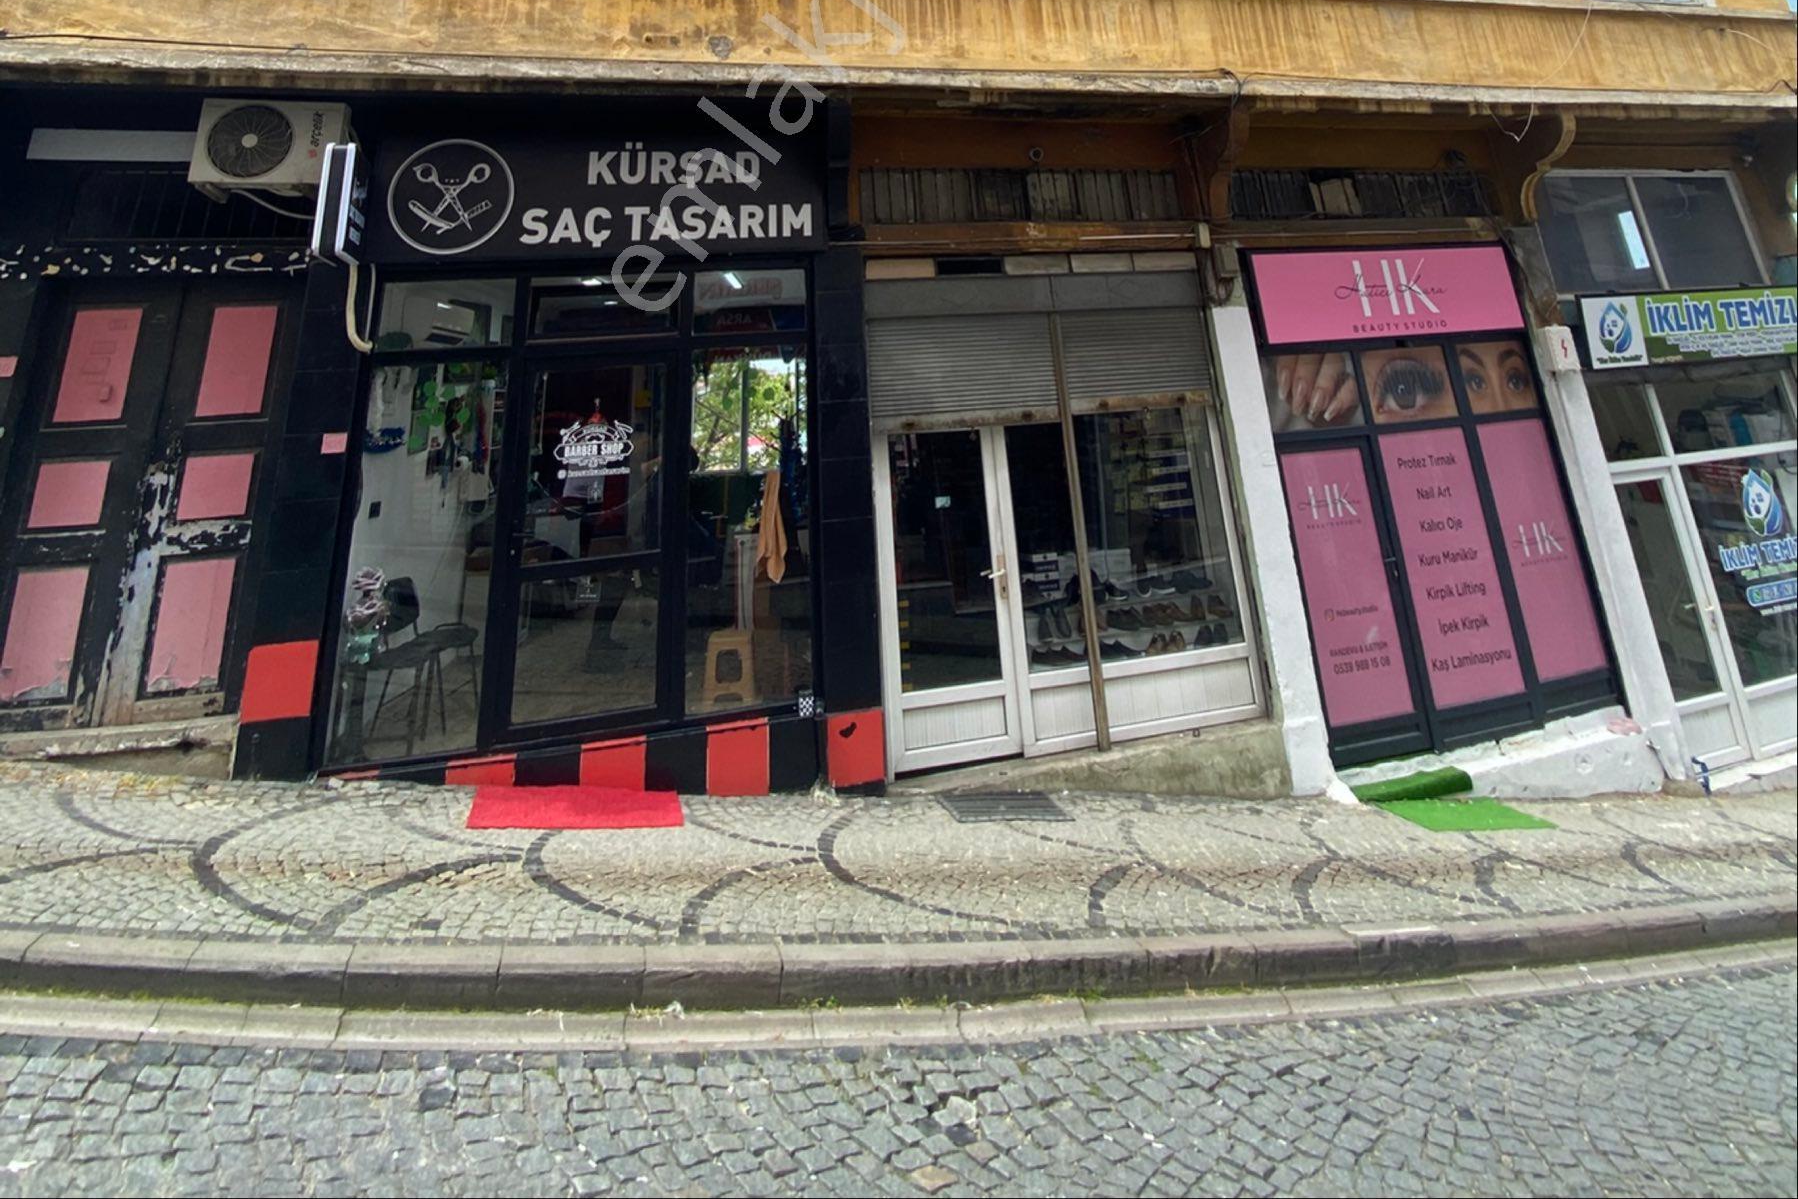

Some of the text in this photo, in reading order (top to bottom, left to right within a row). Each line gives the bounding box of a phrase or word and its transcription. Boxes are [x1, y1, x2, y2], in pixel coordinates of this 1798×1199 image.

[310, 111, 324, 147] arçelik
[587, 142, 761, 189] KÜRŞAD
[519, 203, 813, 248] SAÇ TASARIM
[1352, 258, 1441, 317] HK
[1352, 319, 1448, 334] BEAUTY STUDIO
[1645, 295, 1716, 335] İKLİM
[564, 442, 624, 457] BARBER SHOP
[1397, 453, 1456, 470] Protez Tırnak
[1416, 486, 1452, 500] Nail Art
[1446, 516, 1463, 531] Oje
[1417, 548, 1478, 567] Kuru Manikür
[1718, 541, 1762, 572] İKLİM
[1760, 534, 1797, 563] TEMİ
[1426, 582, 1487, 601] Kirpik Lifting
[1438, 614, 1490, 637] İpek Kirpik
[1431, 649, 1512, 673] Kaş Laminasyonu
